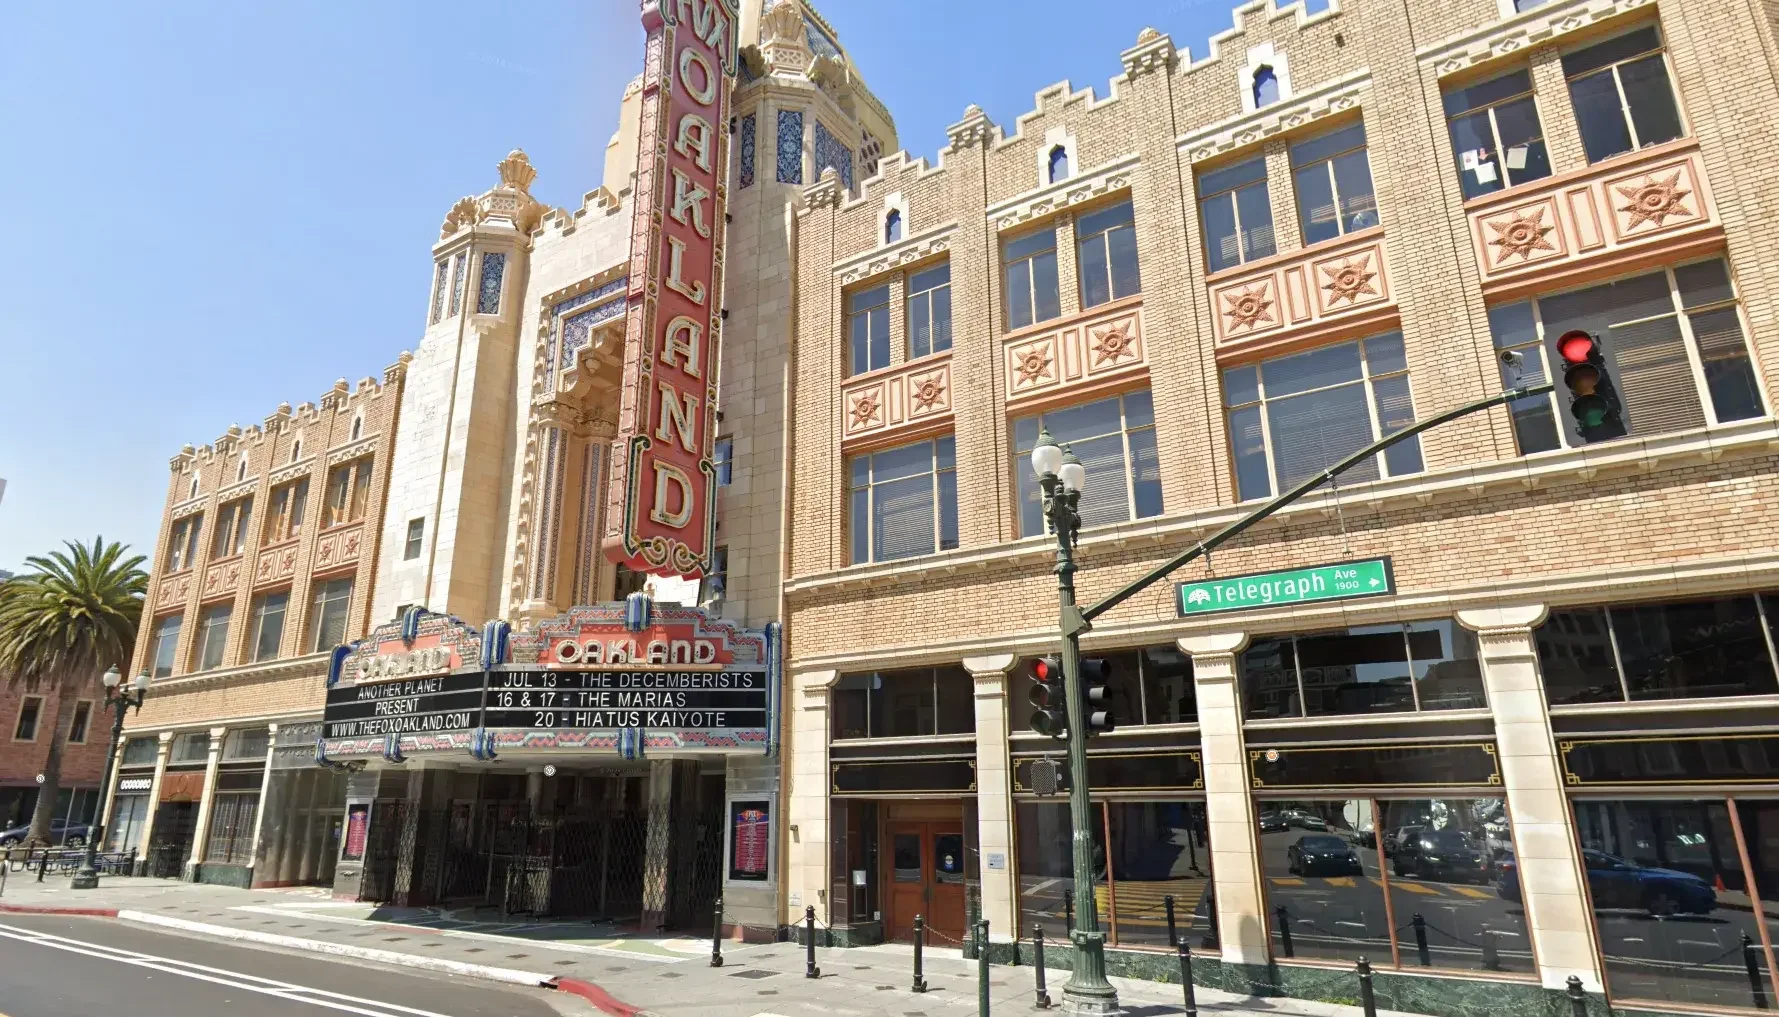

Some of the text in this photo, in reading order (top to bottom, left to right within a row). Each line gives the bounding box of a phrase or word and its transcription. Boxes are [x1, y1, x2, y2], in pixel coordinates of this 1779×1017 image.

[650, 46, 717, 528] OAKLAND
[1334, 568, 1357, 580] Ave
[1213, 573, 1325, 603] Telegraph
[1335, 580, 1359, 590] 1900
[556, 639, 716, 664] OAKLAND
[358, 678, 444, 700] ANOTHER PLANET
[504, 672, 533, 687] JUL
[541, 672, 557, 687] 13
[580, 672, 611, 688] THE
[620, 672, 753, 688] DECEMBERISTS
[375, 698, 420, 716] PRESENT
[497, 692, 513, 707] 16
[520, 692, 531, 707] &
[540, 692, 556, 707] 17
[578, 692, 610, 707] THE
[618, 692, 686, 707] MARIAS
[331, 713, 471, 737] WWW.THEFOXOAKLAND.COM
[535, 711, 554, 727] 20
[575, 711, 640, 727] HIATUS
[647, 711, 726, 727] KAIYOTE
